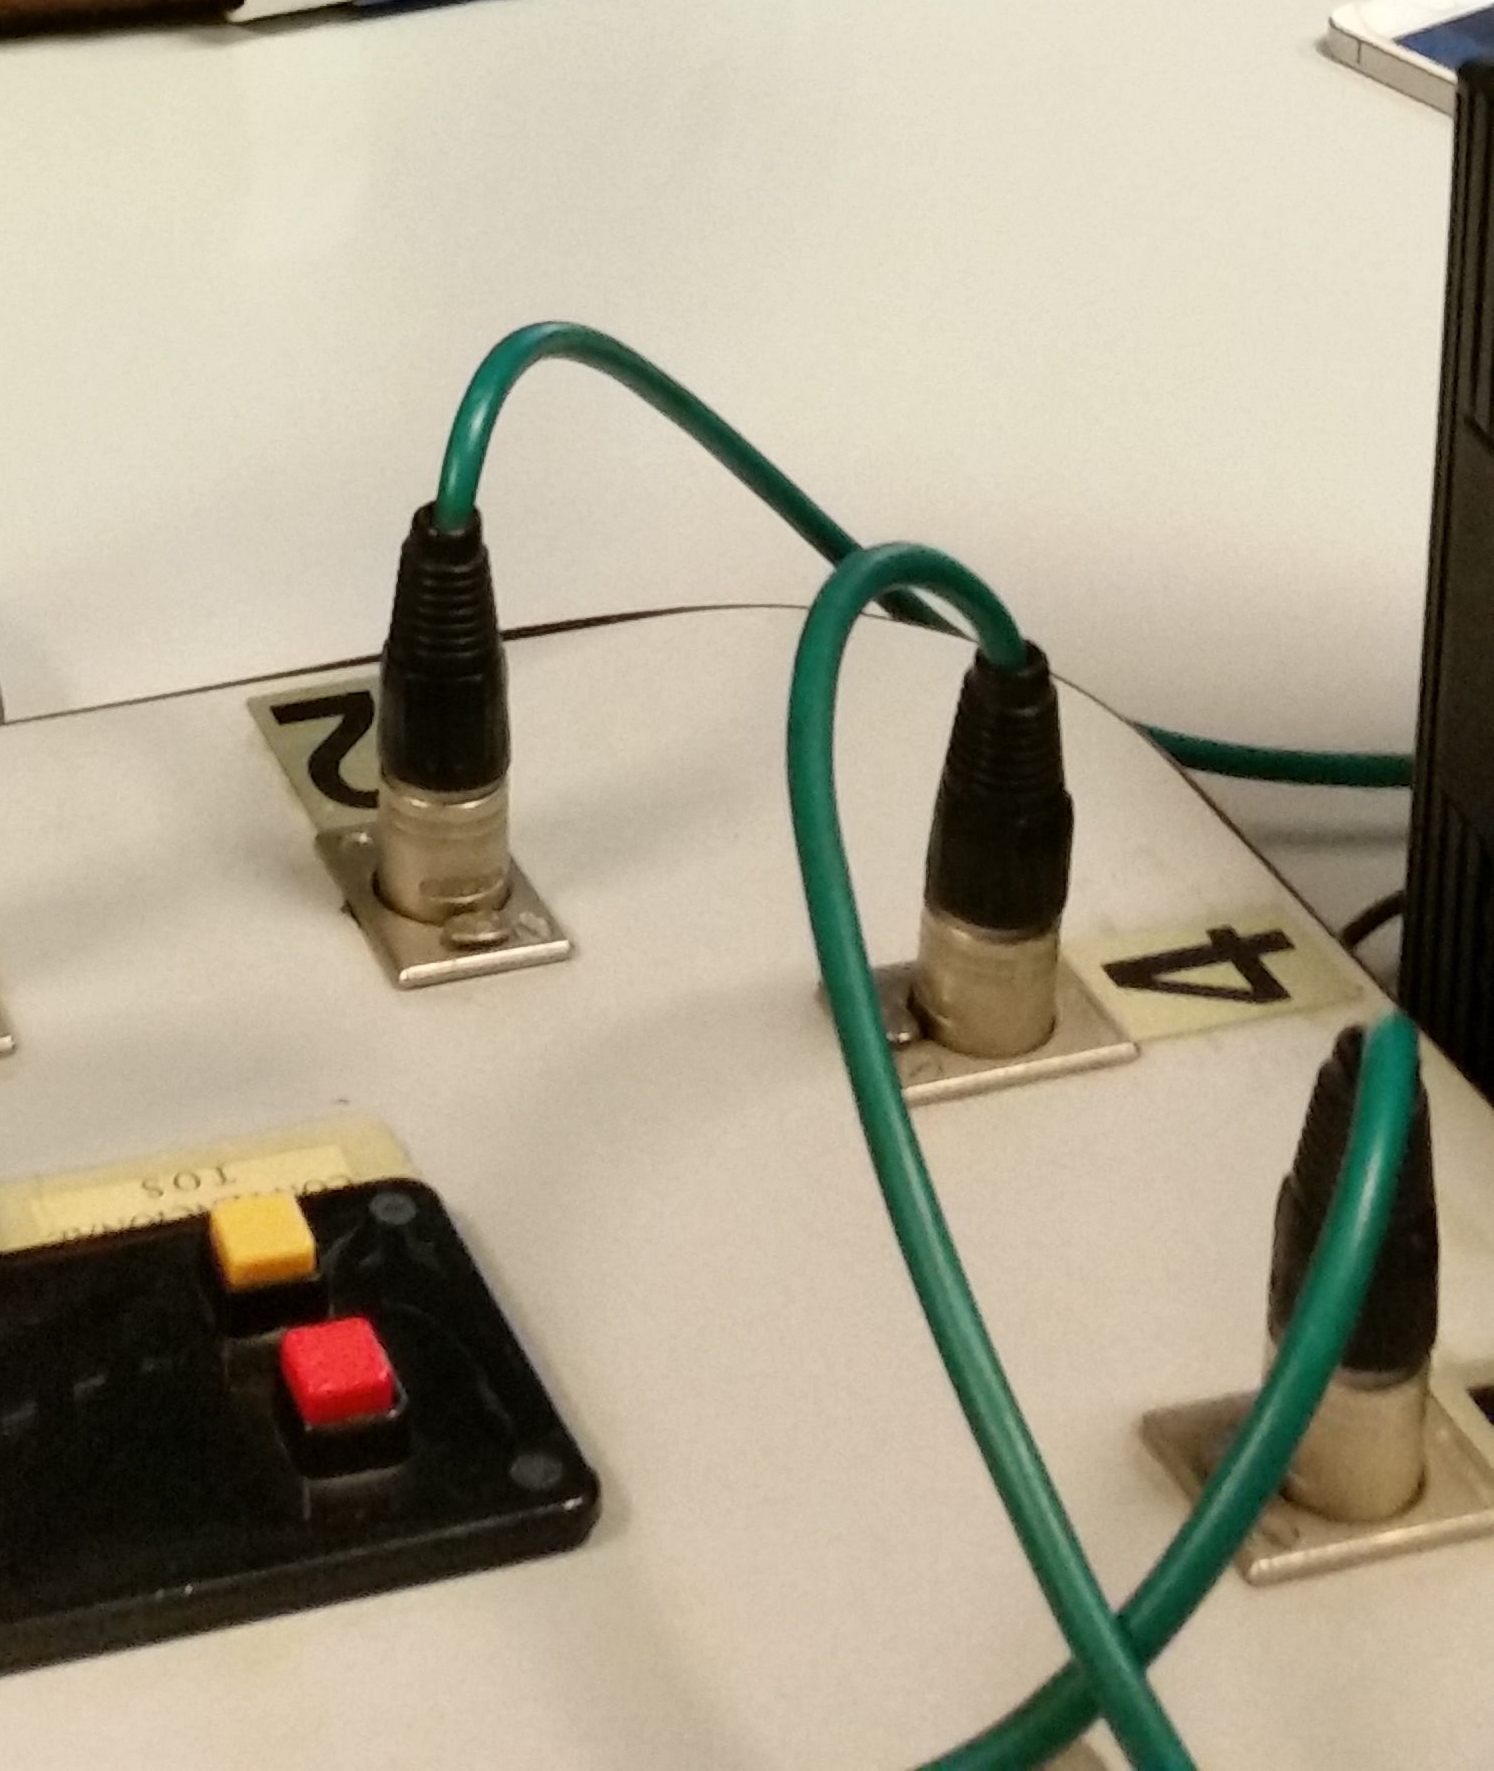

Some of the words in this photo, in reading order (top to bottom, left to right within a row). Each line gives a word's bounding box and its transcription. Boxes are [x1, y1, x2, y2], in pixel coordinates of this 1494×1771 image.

[270, 690, 381, 808] 2
[1101, 924, 1295, 1004] 4
[141, 1165, 236, 1201] TOS
